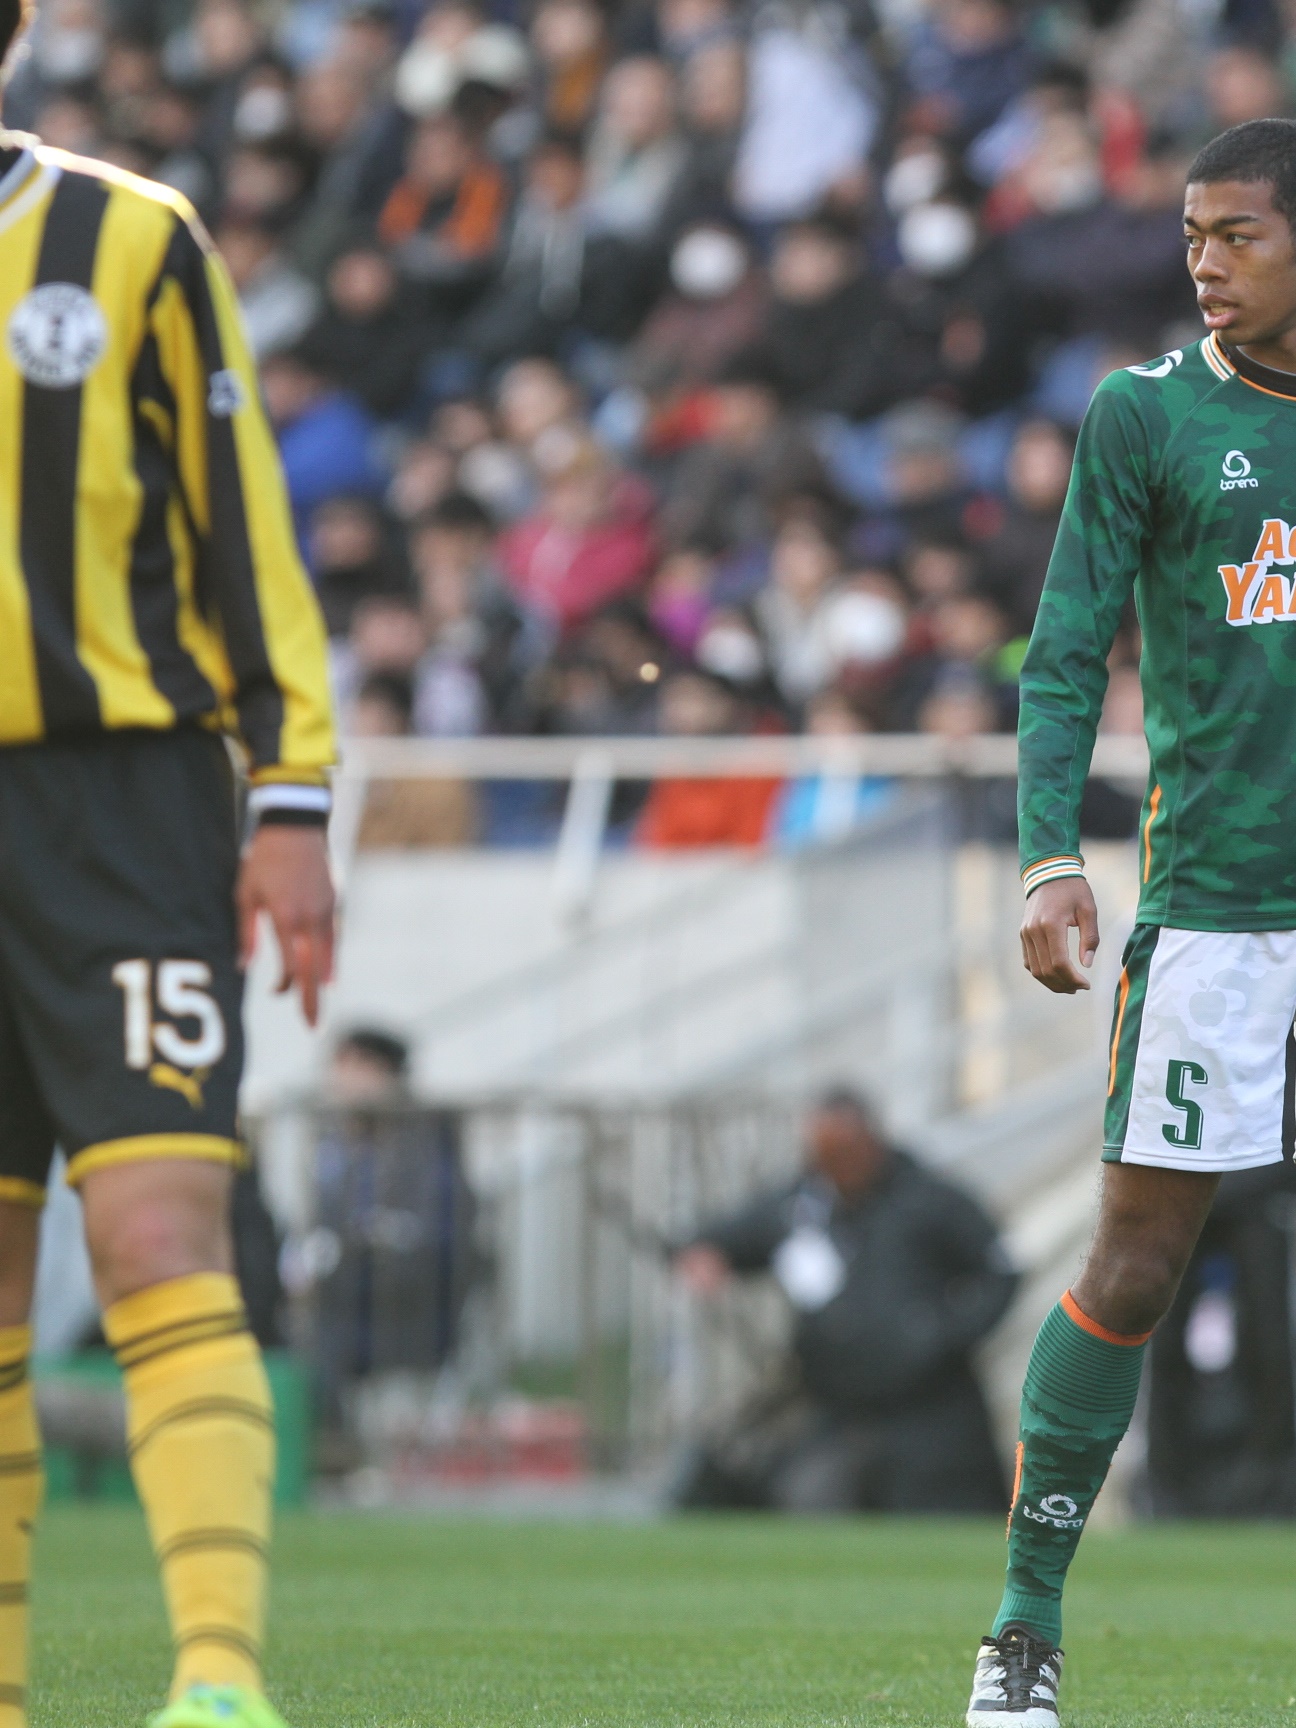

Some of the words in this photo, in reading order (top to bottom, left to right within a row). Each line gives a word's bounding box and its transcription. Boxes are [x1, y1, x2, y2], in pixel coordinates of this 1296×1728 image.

[1220, 478, 1259, 491] borena
[111, 958, 226, 1070] 15
[1161, 1058, 1209, 1151] 5
